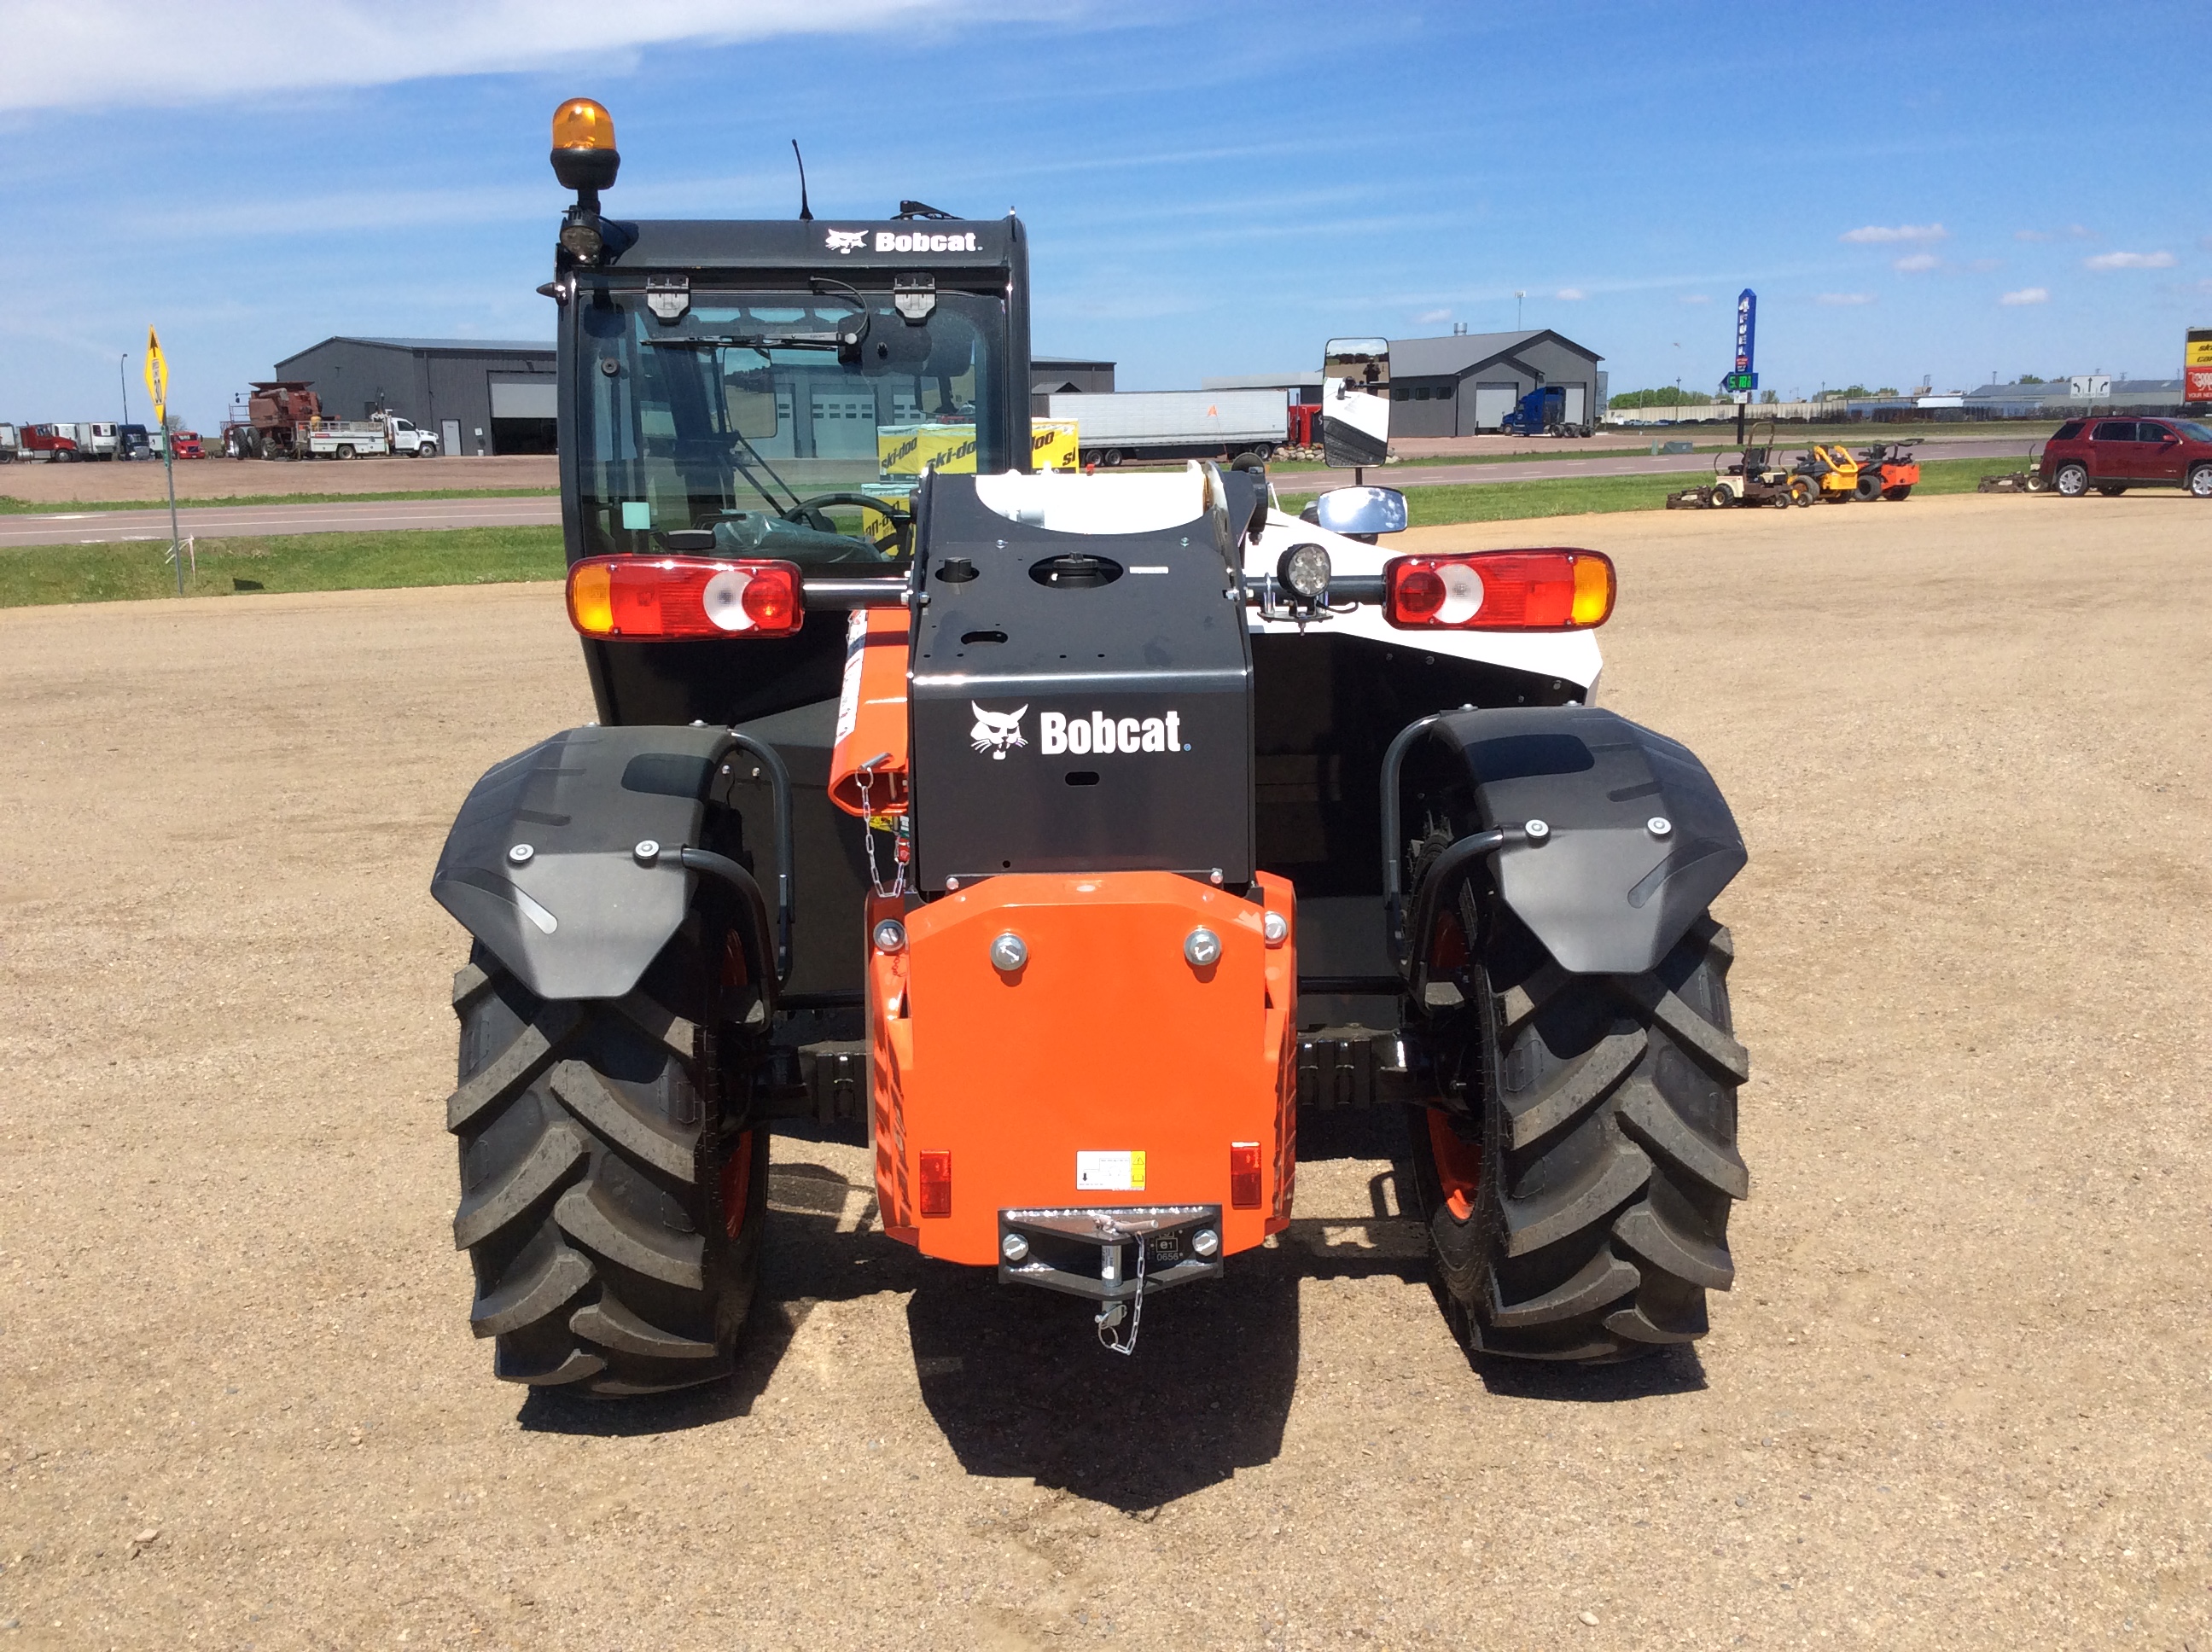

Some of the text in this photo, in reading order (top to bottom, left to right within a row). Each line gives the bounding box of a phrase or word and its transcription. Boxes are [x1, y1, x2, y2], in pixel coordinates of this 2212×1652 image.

[875, 232, 976, 252] Bobcat
[1040, 711, 1181, 754] Bobcat
[1156, 1253, 1179, 1261] 0656
